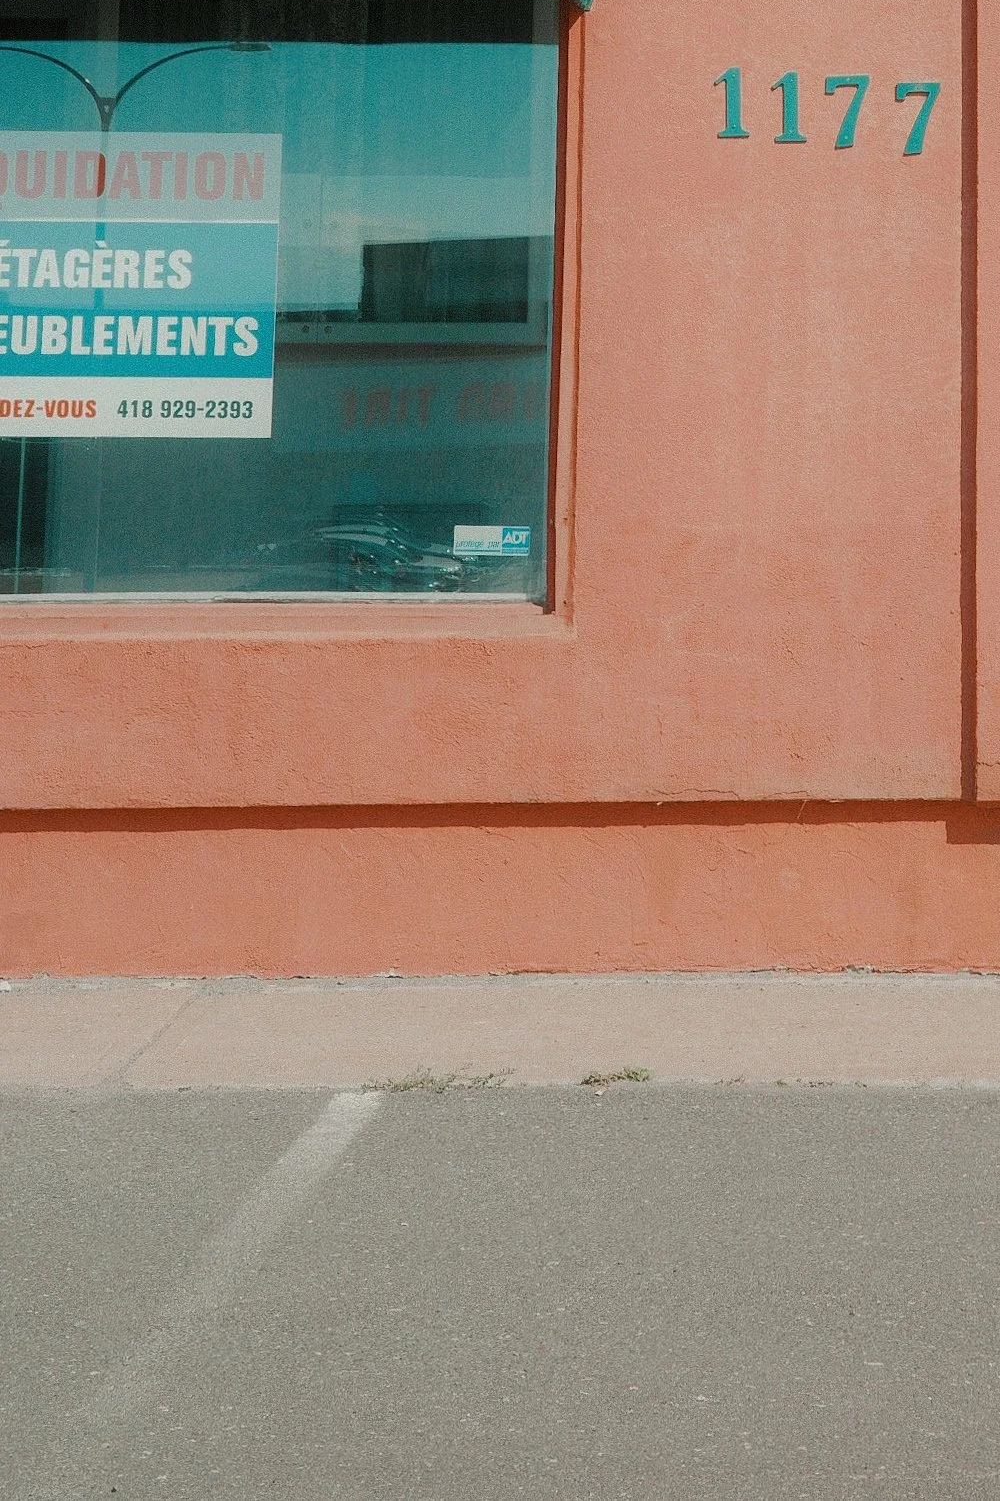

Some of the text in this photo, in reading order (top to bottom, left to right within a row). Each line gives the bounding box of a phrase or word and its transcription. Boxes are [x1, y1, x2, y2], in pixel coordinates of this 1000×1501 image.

[713, 66, 942, 157] 1177
[0, 149, 265, 201] UIDATION
[0, 399, 254, 420] DEZ-VOUS 418 929-2393
[503, 530, 530, 545] ADT
